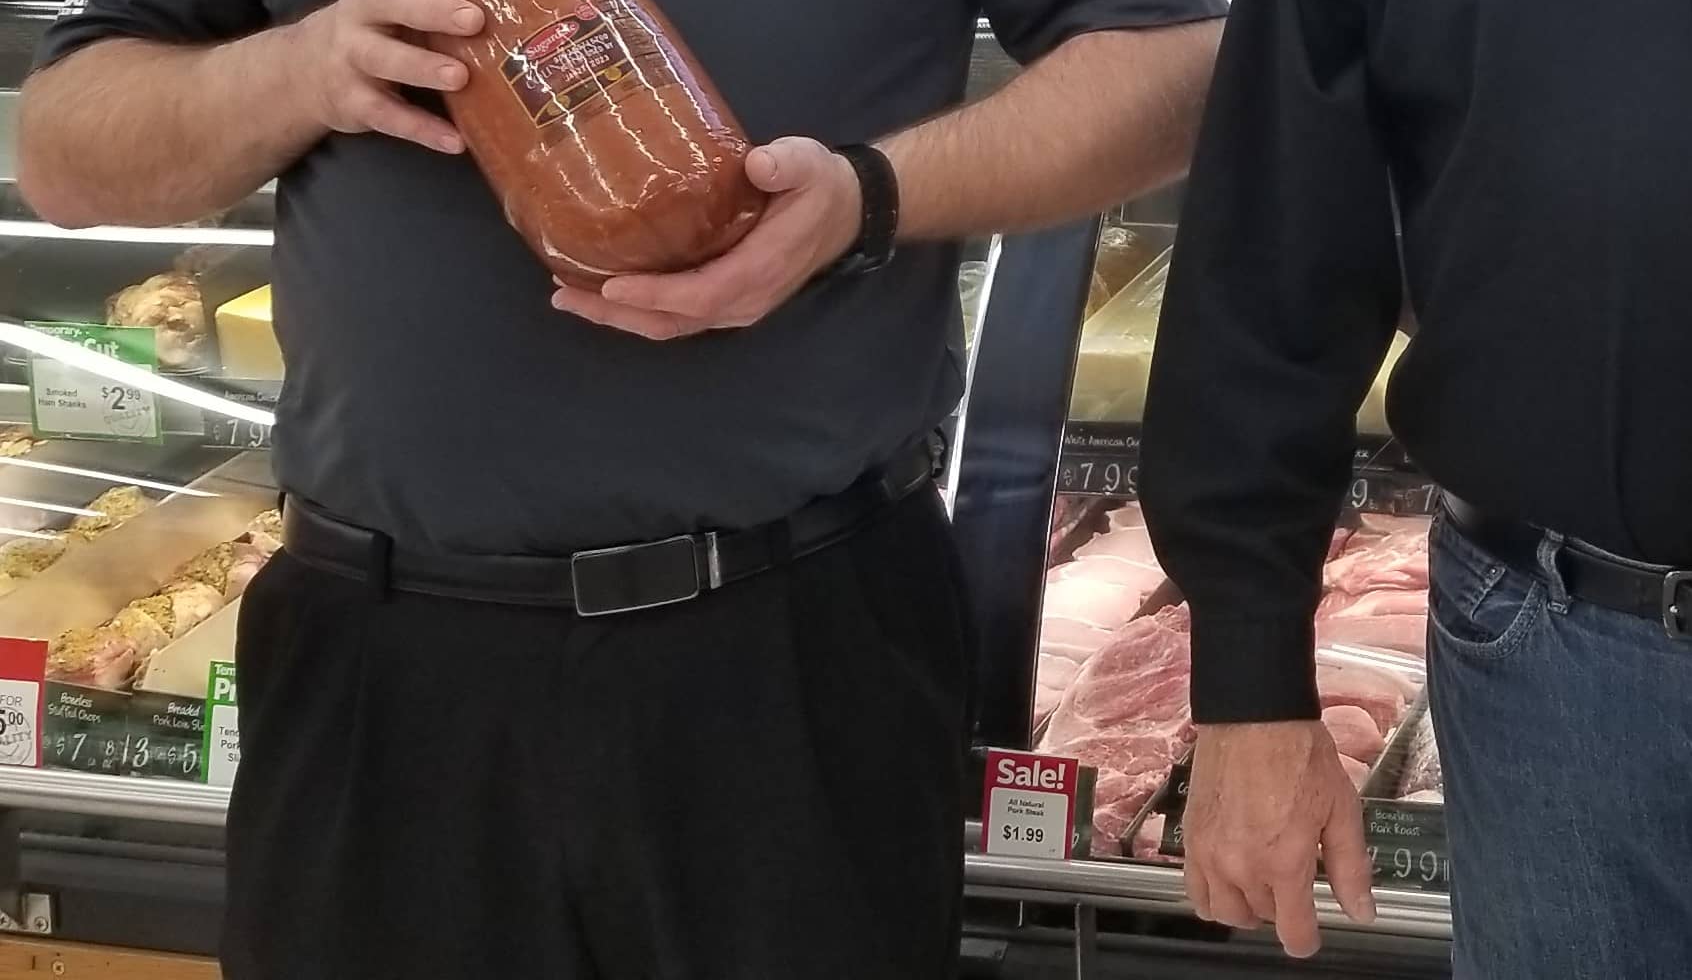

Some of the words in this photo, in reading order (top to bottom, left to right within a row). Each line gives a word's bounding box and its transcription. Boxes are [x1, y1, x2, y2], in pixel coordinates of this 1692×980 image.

[525, 20, 579, 58] Sugarde
[167, 702, 201, 718] Breaded
[153, 714, 173, 726] Pork
[997, 758, 1066, 790] Sale!
[1008, 798, 1018, 806] All
[1002, 824, 1044, 843] $1.99
[1370, 822, 1391, 835] Pork
[1393, 823, 1421, 837] Roast
